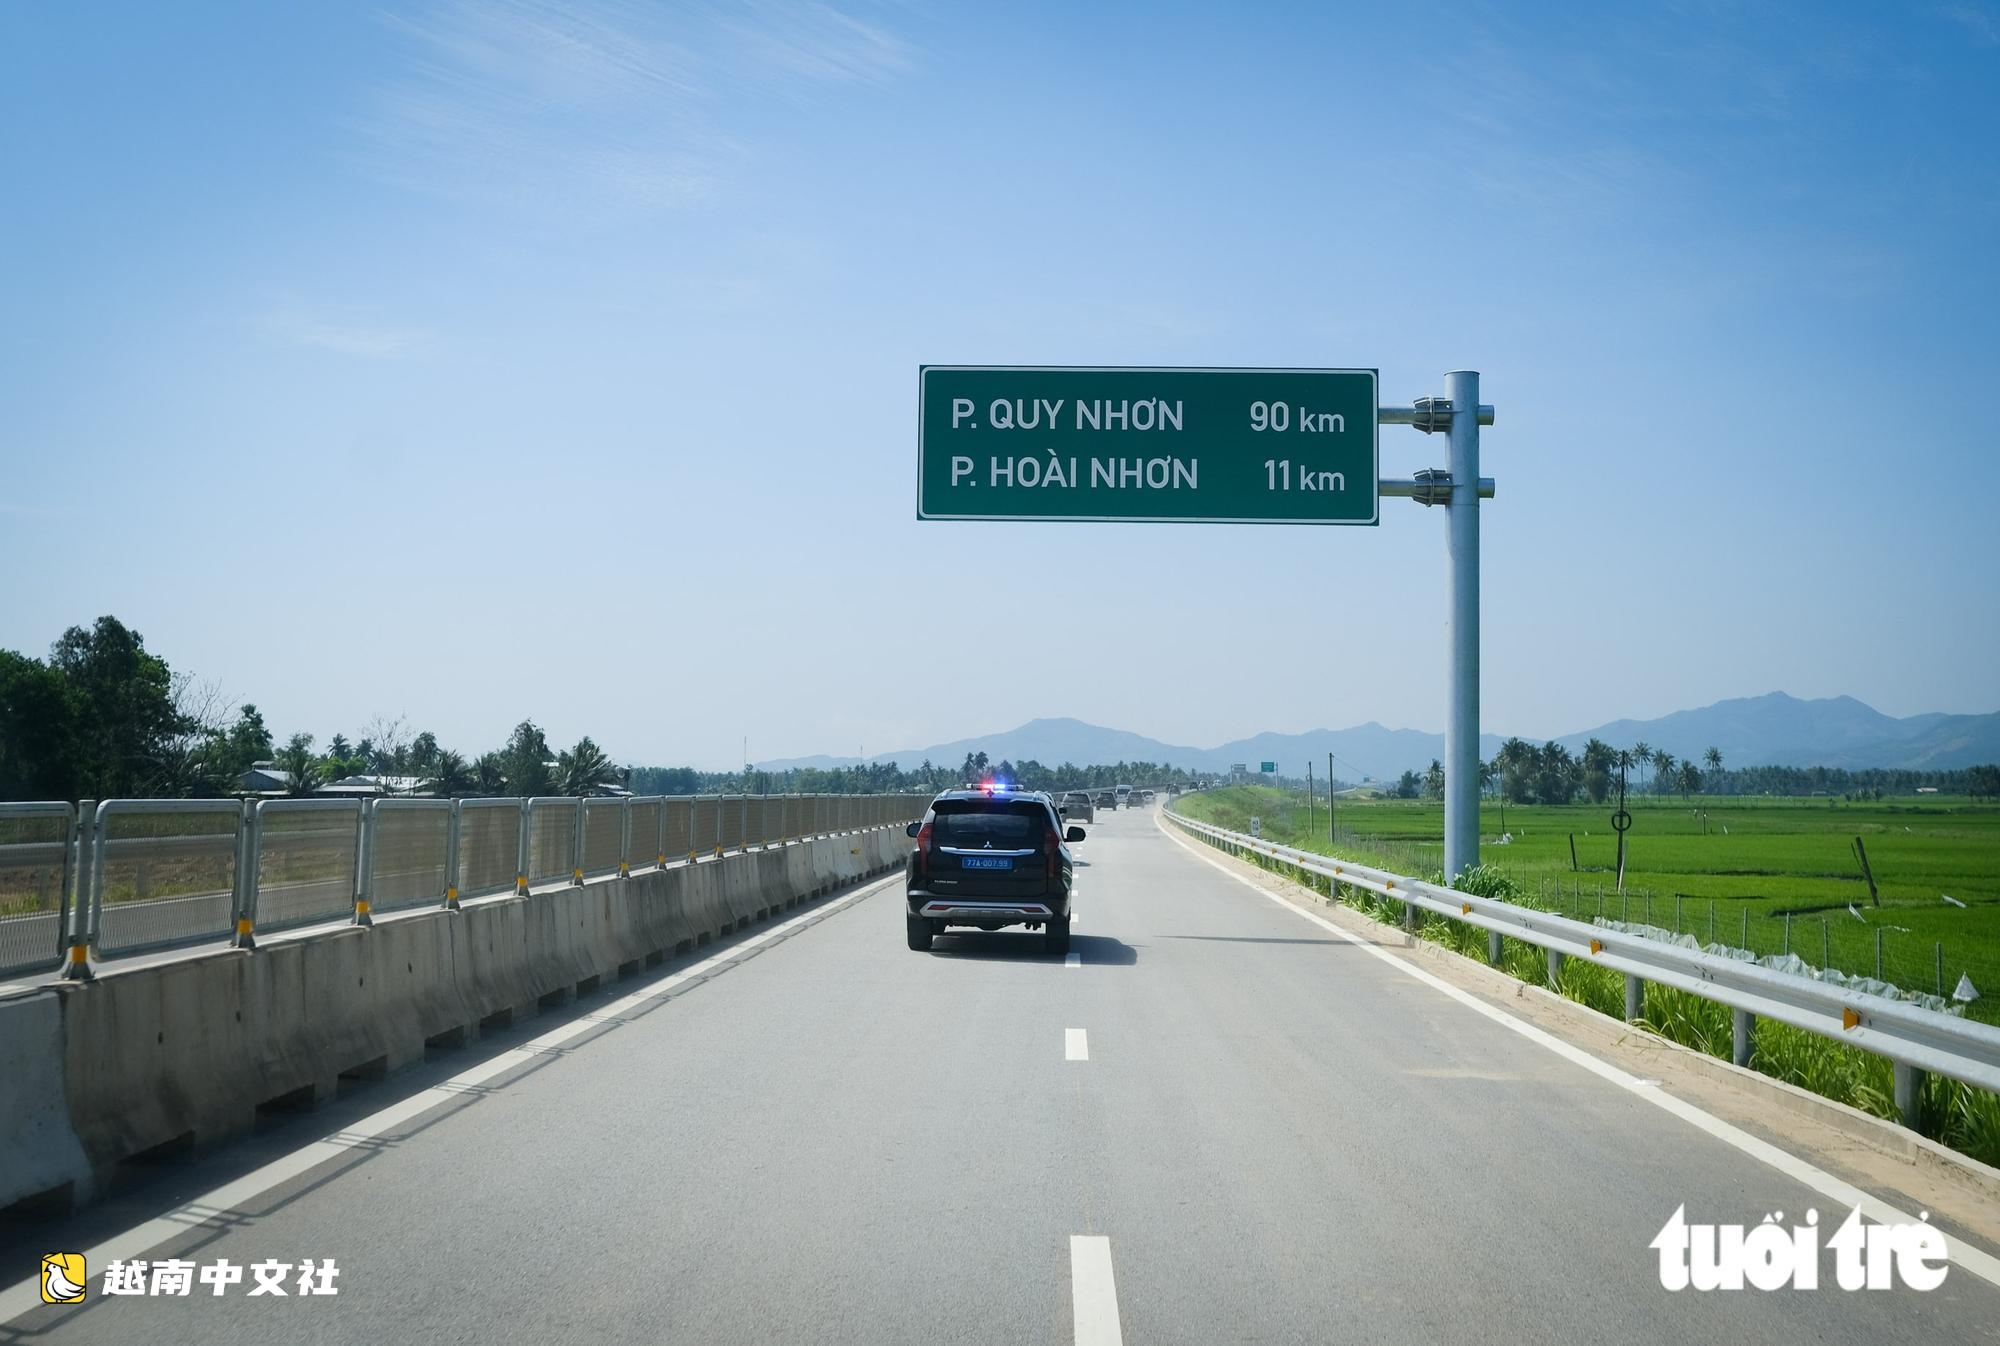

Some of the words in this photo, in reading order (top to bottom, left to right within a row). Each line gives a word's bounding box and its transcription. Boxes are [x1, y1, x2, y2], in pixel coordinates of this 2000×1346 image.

[952, 398, 977, 429] P.
[989, 398, 1065, 430] QUY
[1076, 396, 1183, 431] NHƠN
[1250, 400, 1290, 432] 90
[1300, 406, 1345, 433] km
[951, 456, 976, 487] P.
[990, 448, 1077, 488] HOÀI
[1090, 454, 1198, 489] NHƠN
[1264, 459, 1290, 490] 11
[1300, 464, 1345, 491] km
